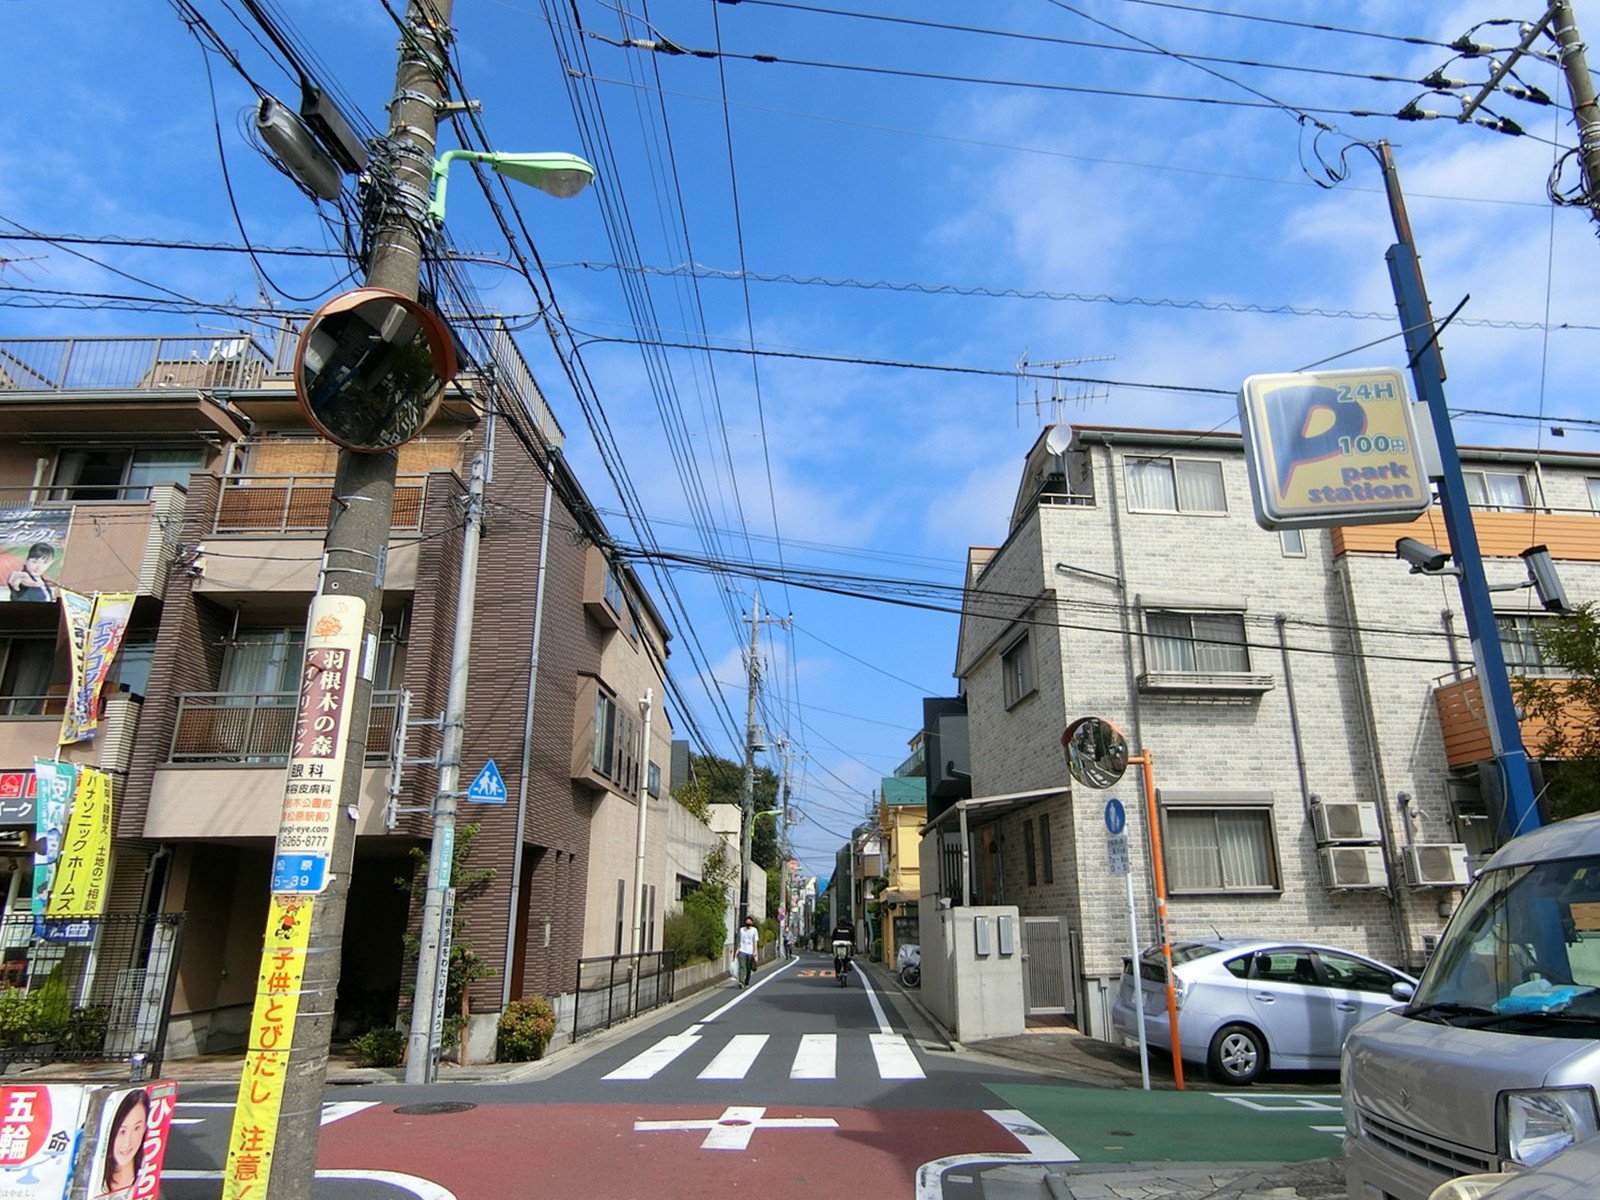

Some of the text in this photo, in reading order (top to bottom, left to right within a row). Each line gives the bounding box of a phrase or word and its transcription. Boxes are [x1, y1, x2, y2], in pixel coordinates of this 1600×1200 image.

[1336, 382, 1395, 402] 24H
[1339, 435, 1407, 455] 100円
[1341, 461, 1411, 486] park
[1308, 482, 1414, 503] station
[293, 650, 319, 756] アイクリニック
[310, 650, 346, 756] 羽根木の森
[291, 763, 324, 778] 眼科
[250, 946, 295, 1104] 子供とびだし
[0, 1090, 37, 1160] 五輪
[48, 1130, 70, 1152] 命
[134, 1099, 171, 1200] ひうち
